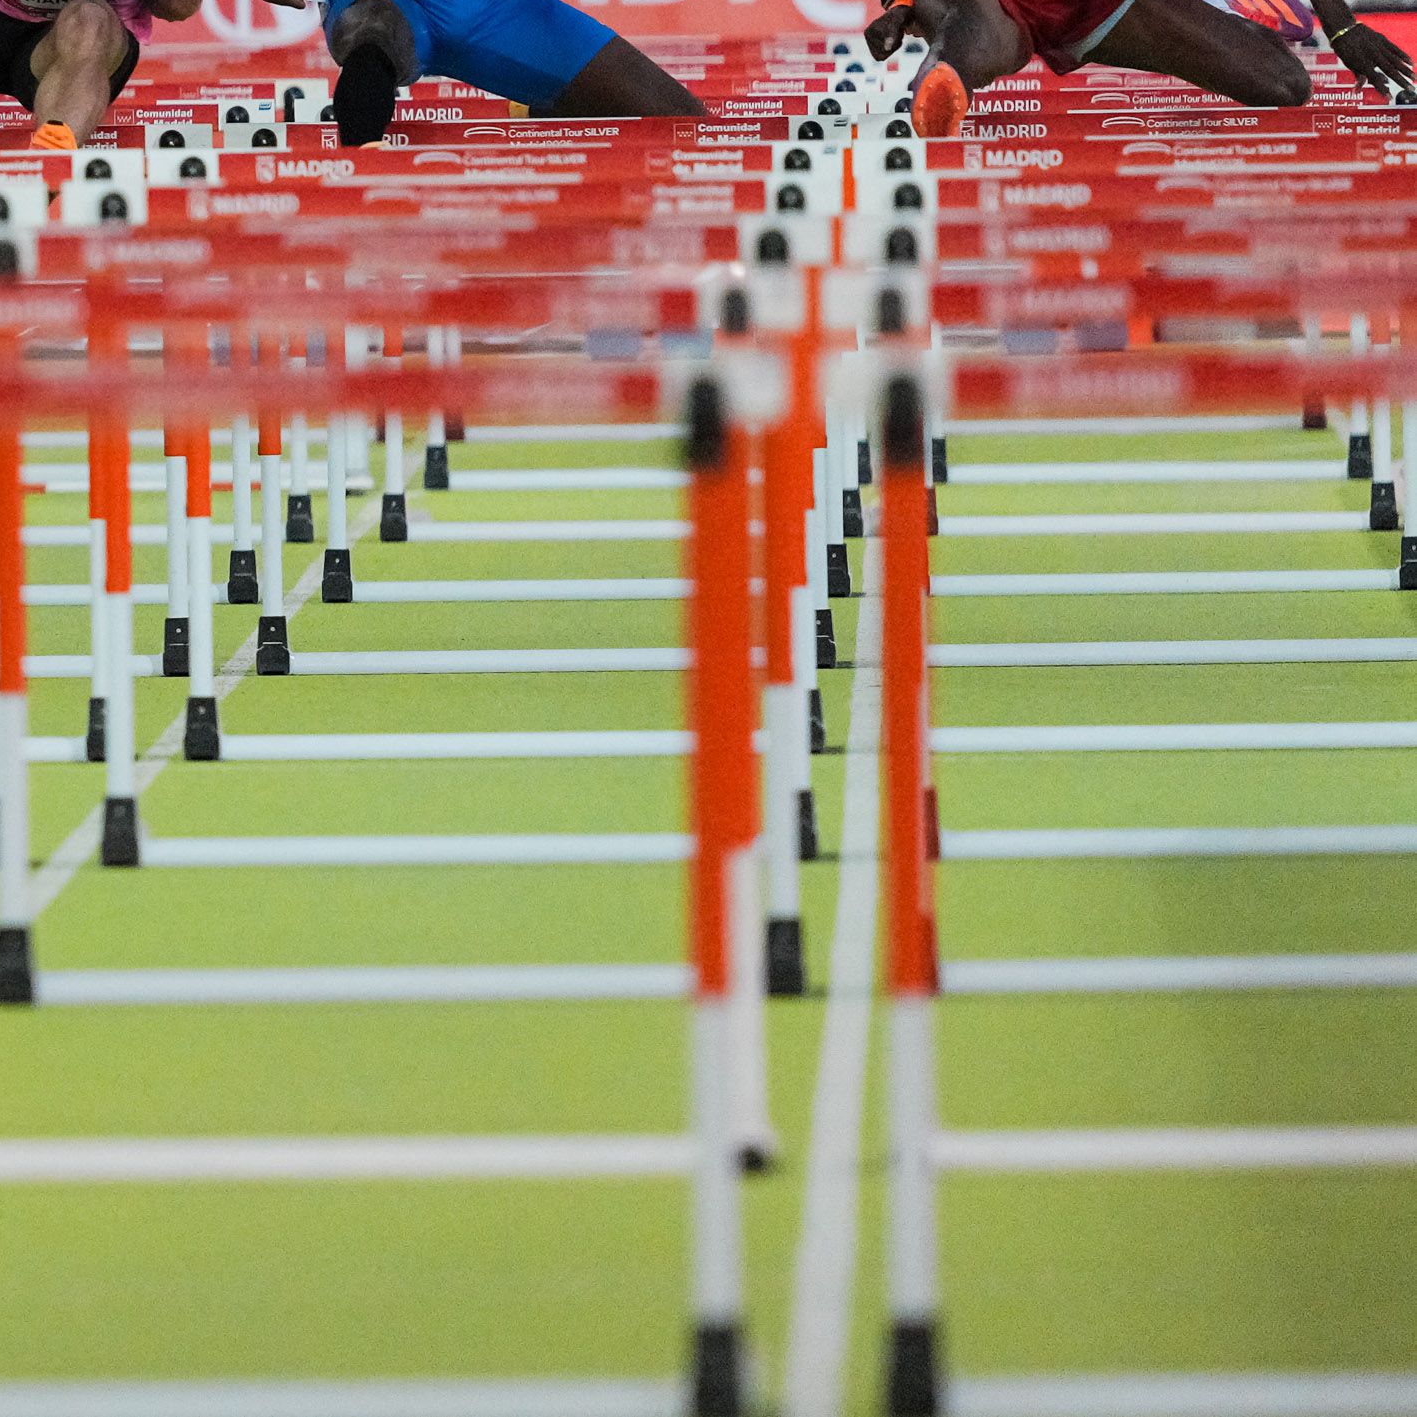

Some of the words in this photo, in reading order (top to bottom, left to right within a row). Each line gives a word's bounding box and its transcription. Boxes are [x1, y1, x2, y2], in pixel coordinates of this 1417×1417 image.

[1132, 94, 1181, 104] Continental
[1183, 94, 1200, 104] Tour
[1311, 91, 1363, 101] omunidad
[726, 101, 783, 110] Comunidad
[979, 100, 1041, 113] MADRID
[136, 109, 193, 119] Comunidad
[402, 107, 462, 121] MADRID
[1337, 114, 1400, 123] Comunidad
[698, 123, 761, 132] Comunidad
[1147, 118, 1199, 128] Continental
[1201, 118, 1220, 128] Tour
[1223, 118, 1258, 127] SILVER
[508, 128, 562, 138] Continental
[564, 128, 583, 138] Tour
[585, 127, 619, 137] SILVER
[979, 125, 1047, 139] MADRID
[1337, 125, 1352, 134] de
[1356, 125, 1400, 134] Madrid
[698, 134, 712, 142] de
[716, 134, 761, 142] Madrid
[986, 150, 1063, 168] MADRID
[278, 160, 355, 178] MADRID
